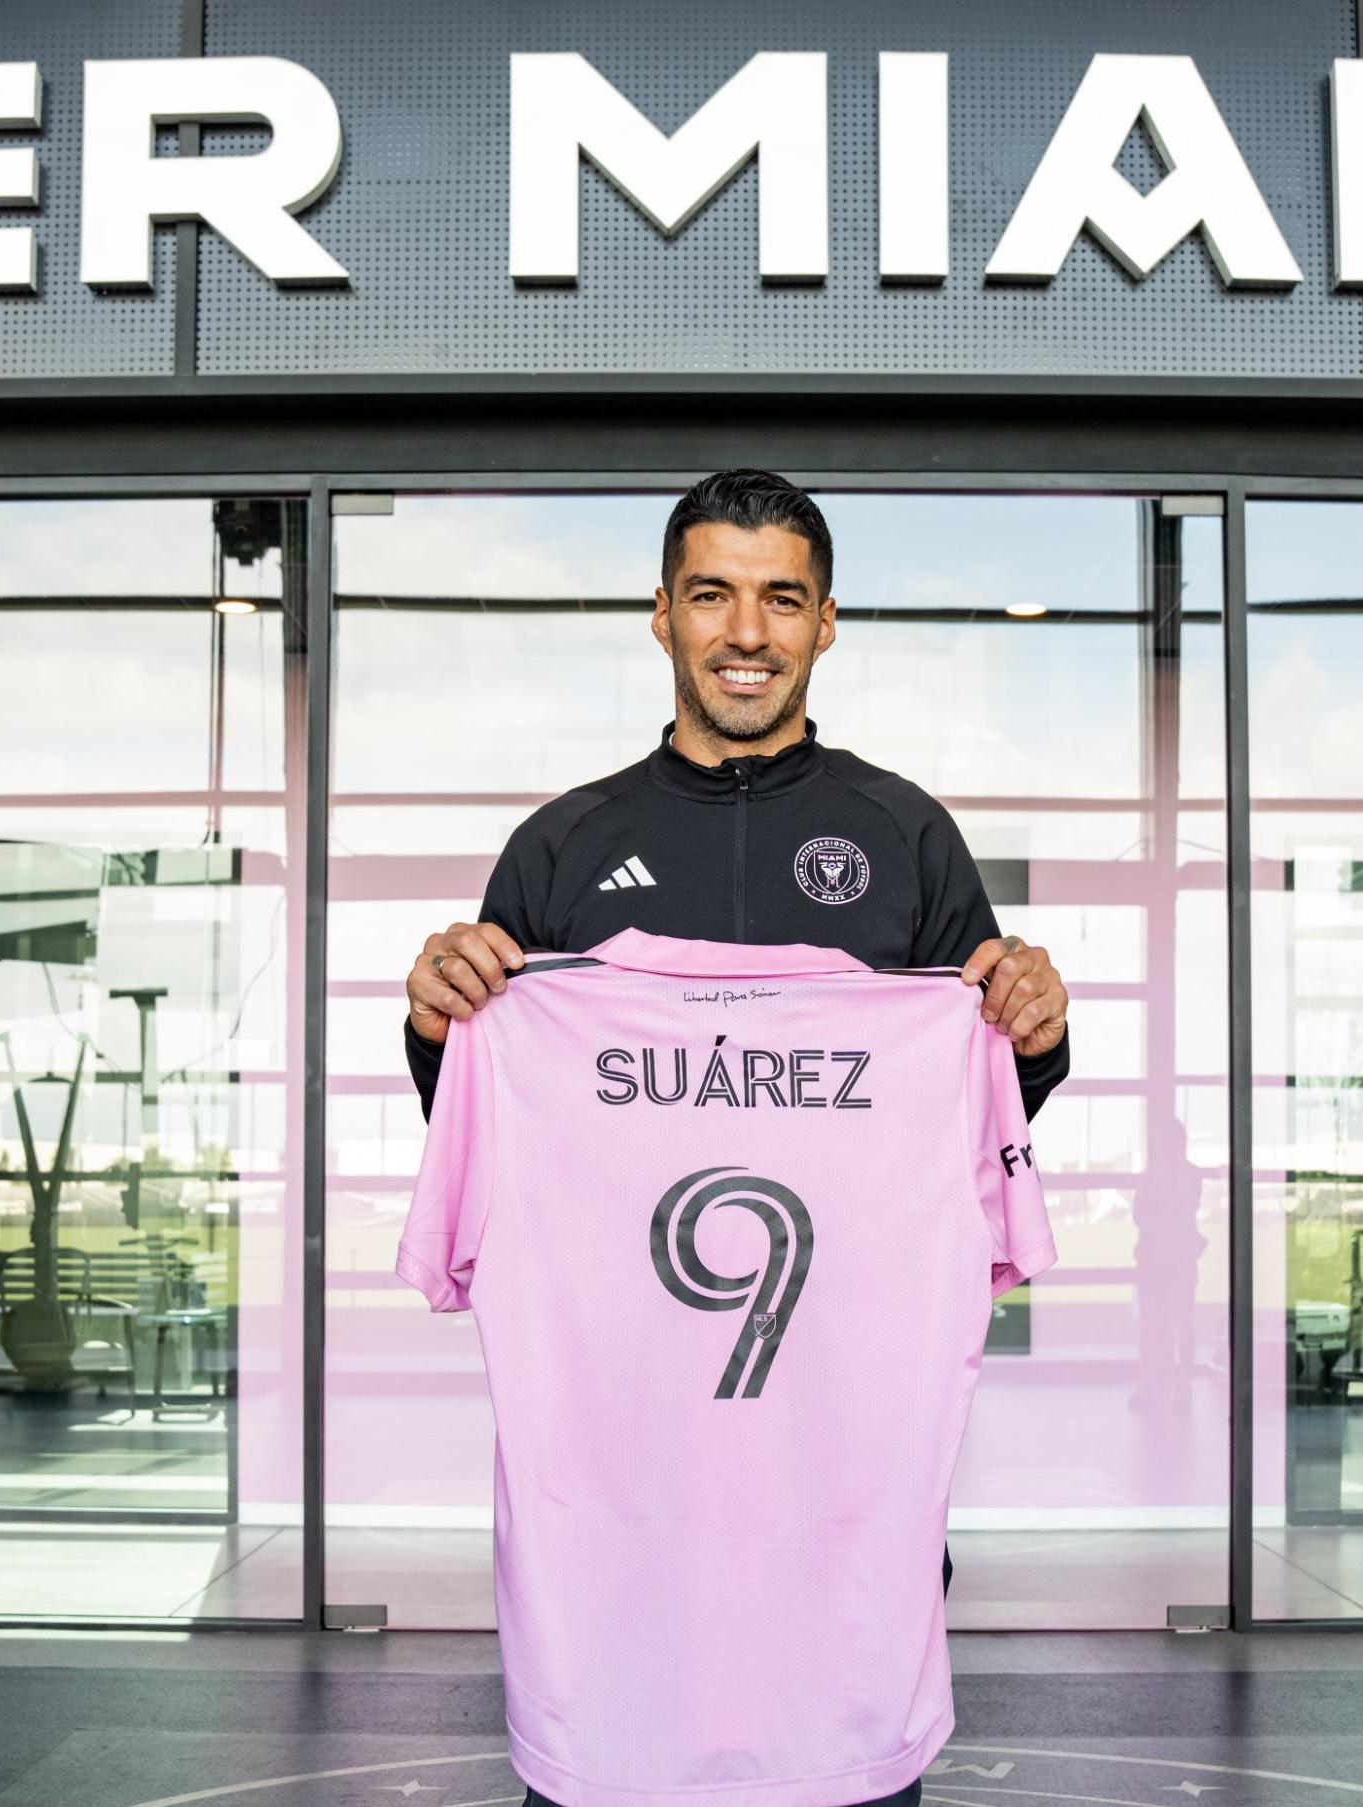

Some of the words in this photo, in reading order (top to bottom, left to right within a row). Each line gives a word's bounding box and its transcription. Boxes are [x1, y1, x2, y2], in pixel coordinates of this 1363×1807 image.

[798, 841, 855, 865] INTERNACIONAL
[798, 868, 809, 887] CLUB
[596, 1035, 872, 1109] SUÁREZ
[649, 1166, 814, 1400] 9
